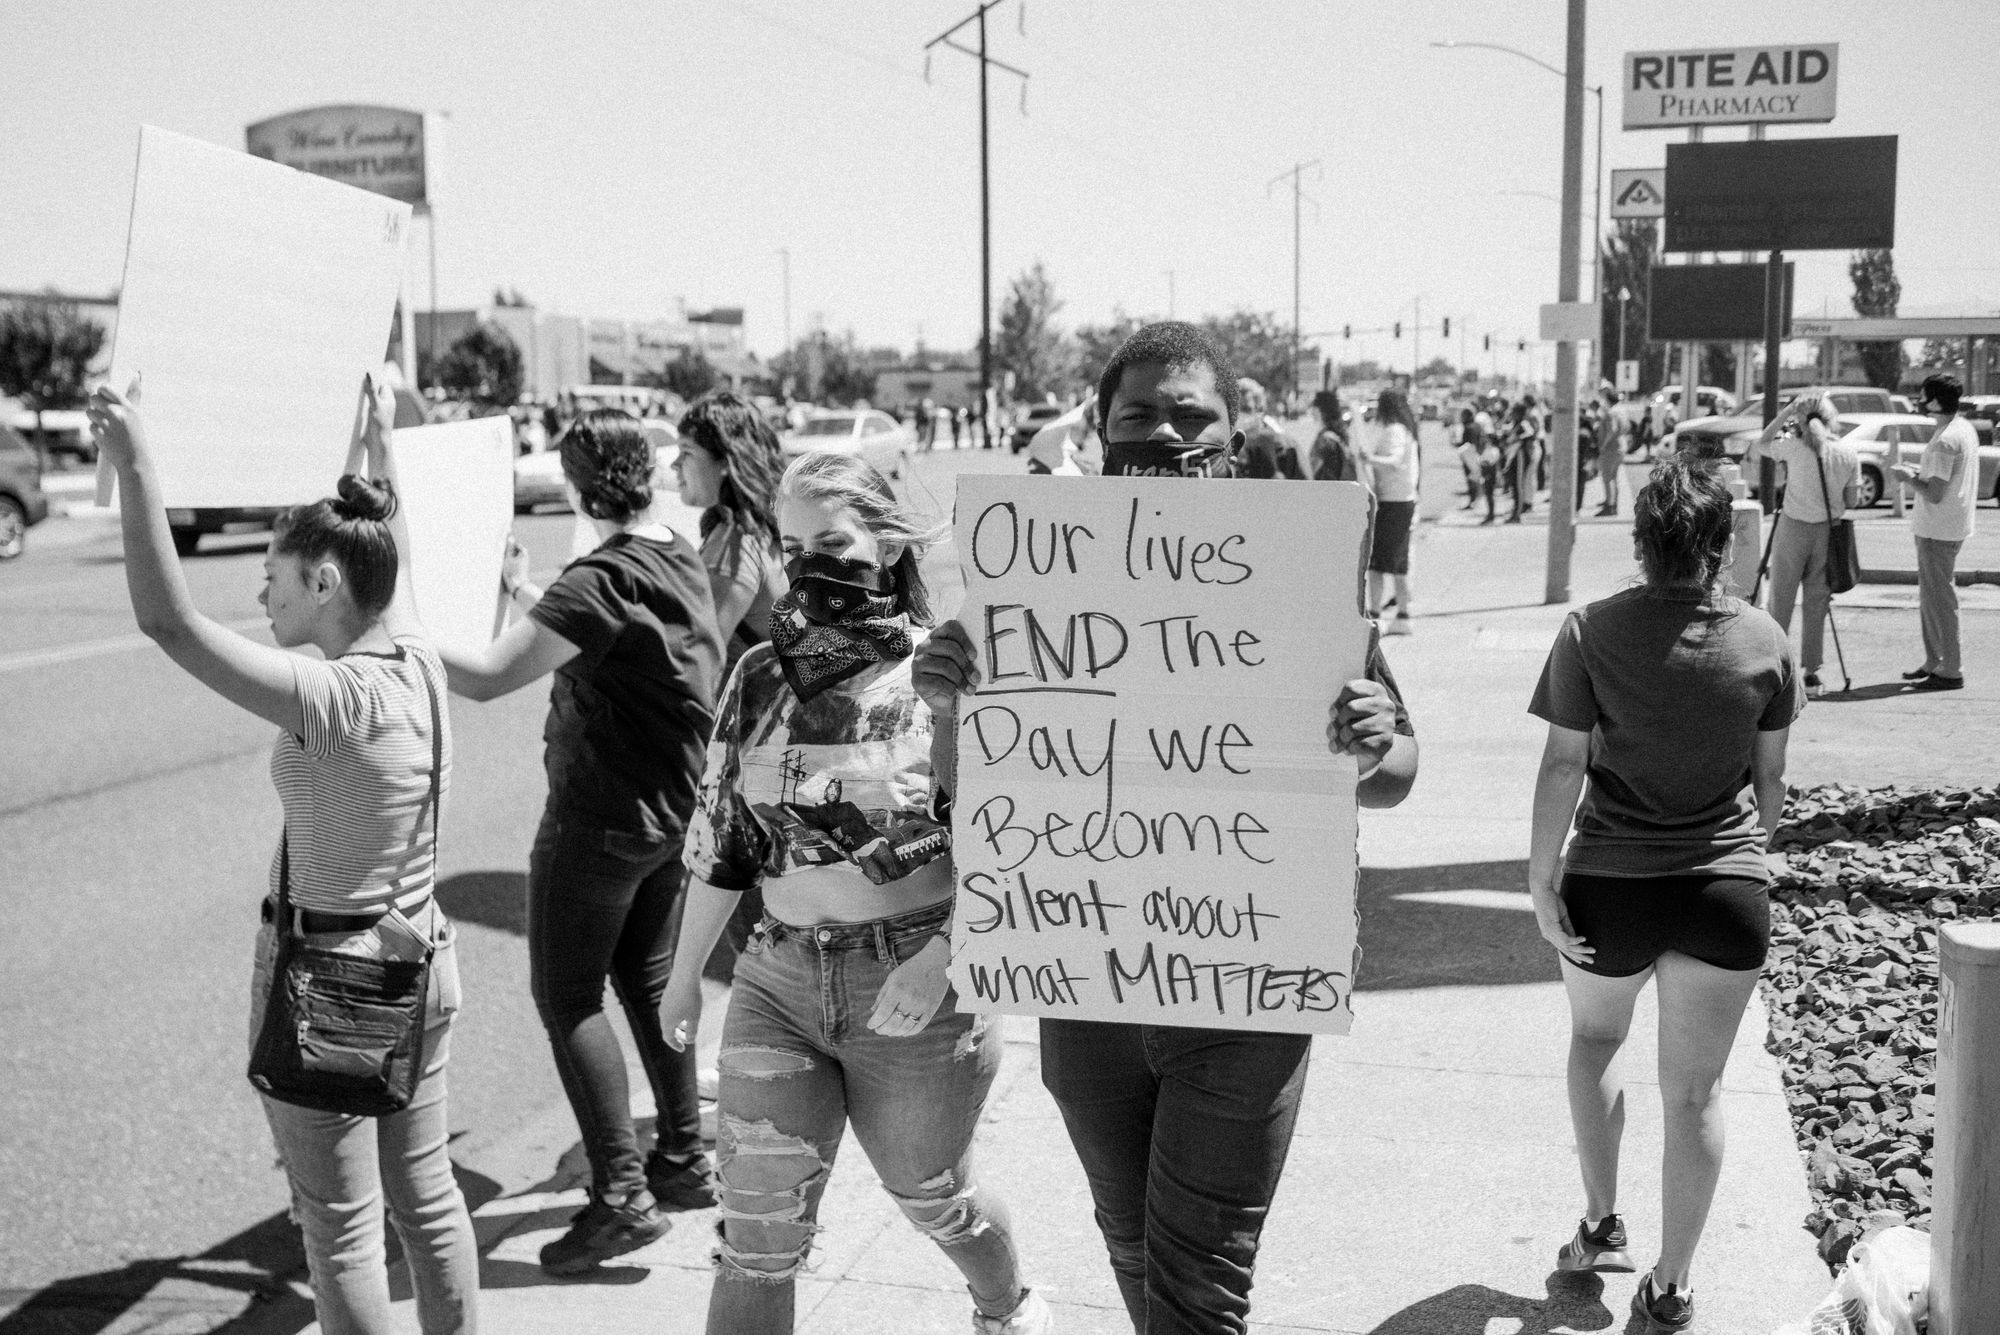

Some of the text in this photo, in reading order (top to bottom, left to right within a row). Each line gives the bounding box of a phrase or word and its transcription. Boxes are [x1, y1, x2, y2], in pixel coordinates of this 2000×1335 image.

[1632, 49, 1829, 90] RITE AID
[1660, 94, 1800, 118] PHARMACY
[972, 497, 1253, 585] Our lives
[984, 603, 1265, 684] END The
[962, 706, 1253, 825] Day we
[971, 795, 1275, 872] Become
[961, 871, 1280, 941] Silent about
[968, 955, 1089, 1005] what
